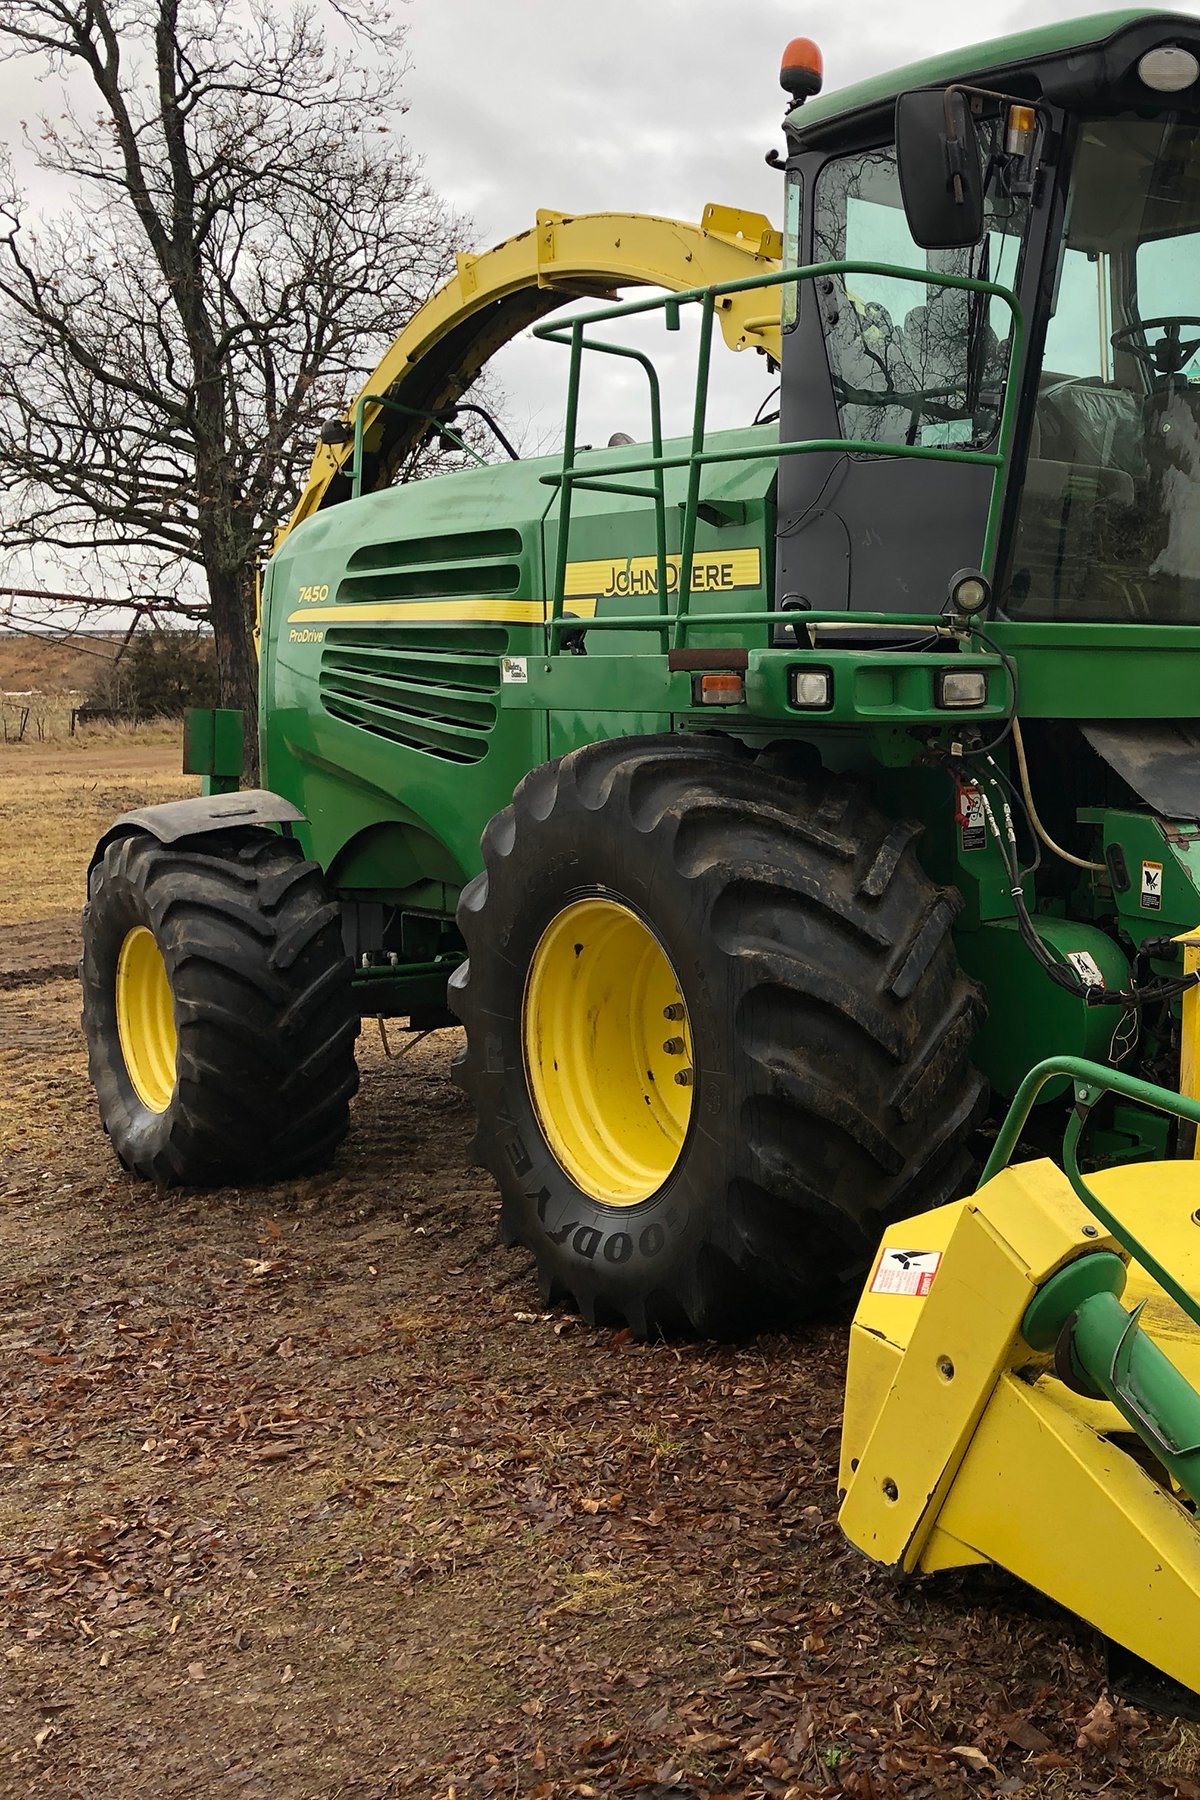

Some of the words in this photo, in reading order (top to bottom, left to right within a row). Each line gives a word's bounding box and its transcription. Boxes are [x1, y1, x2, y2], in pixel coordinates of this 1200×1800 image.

[605, 567, 658, 593] JOHN
[664, 563, 734, 589] DERE
[298, 584, 329, 603] 7450
[288, 628, 324, 643] ProDrive
